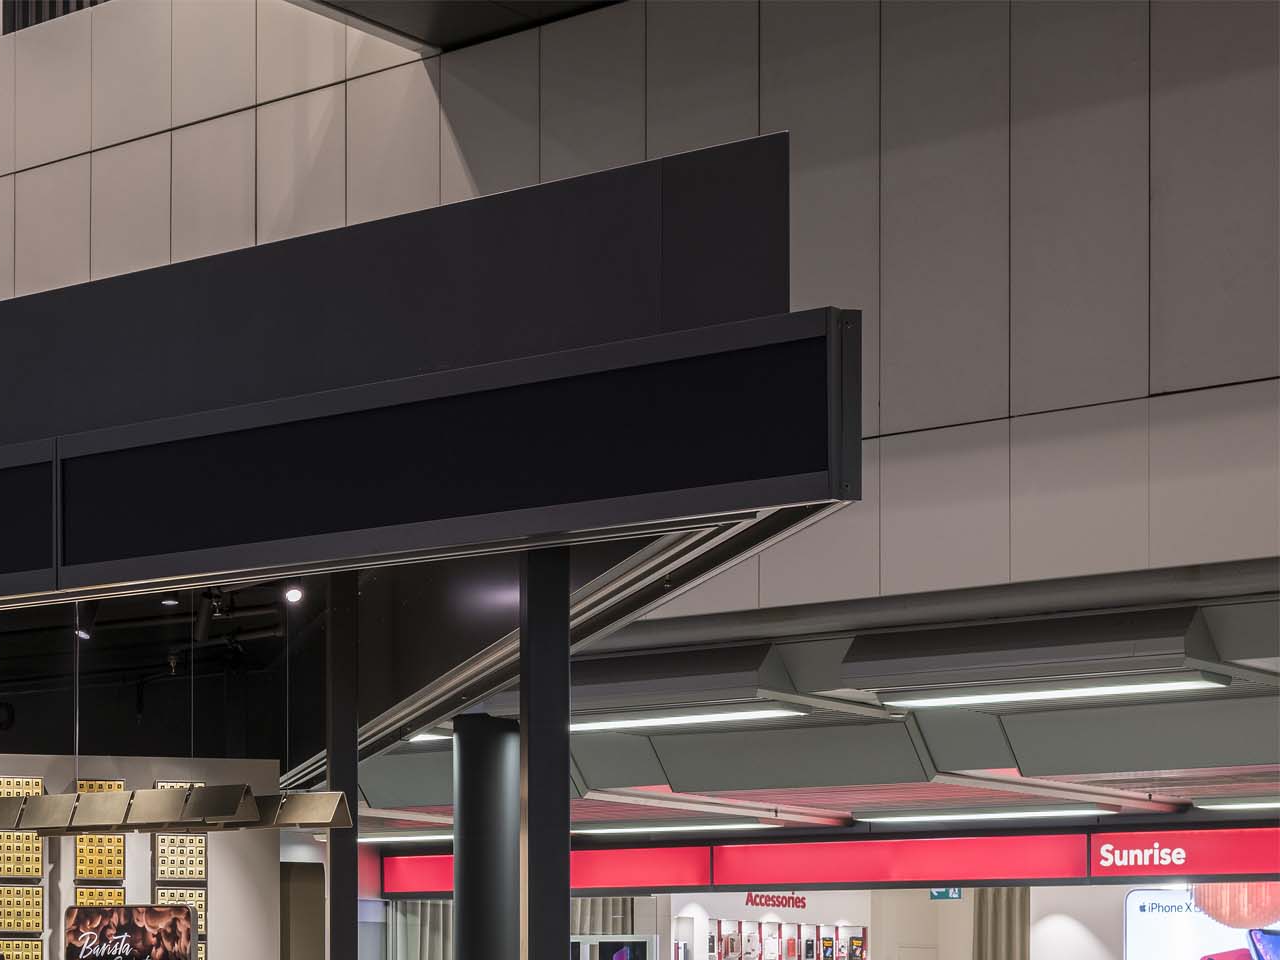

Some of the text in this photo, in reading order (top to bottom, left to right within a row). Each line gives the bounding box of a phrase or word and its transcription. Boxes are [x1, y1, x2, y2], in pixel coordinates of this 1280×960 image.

[1100, 842, 1186, 867] Sunrise
[745, 888, 807, 909] Accessories
[1148, 902, 1183, 912] iPhone
[78, 931, 133, 959] Barista
